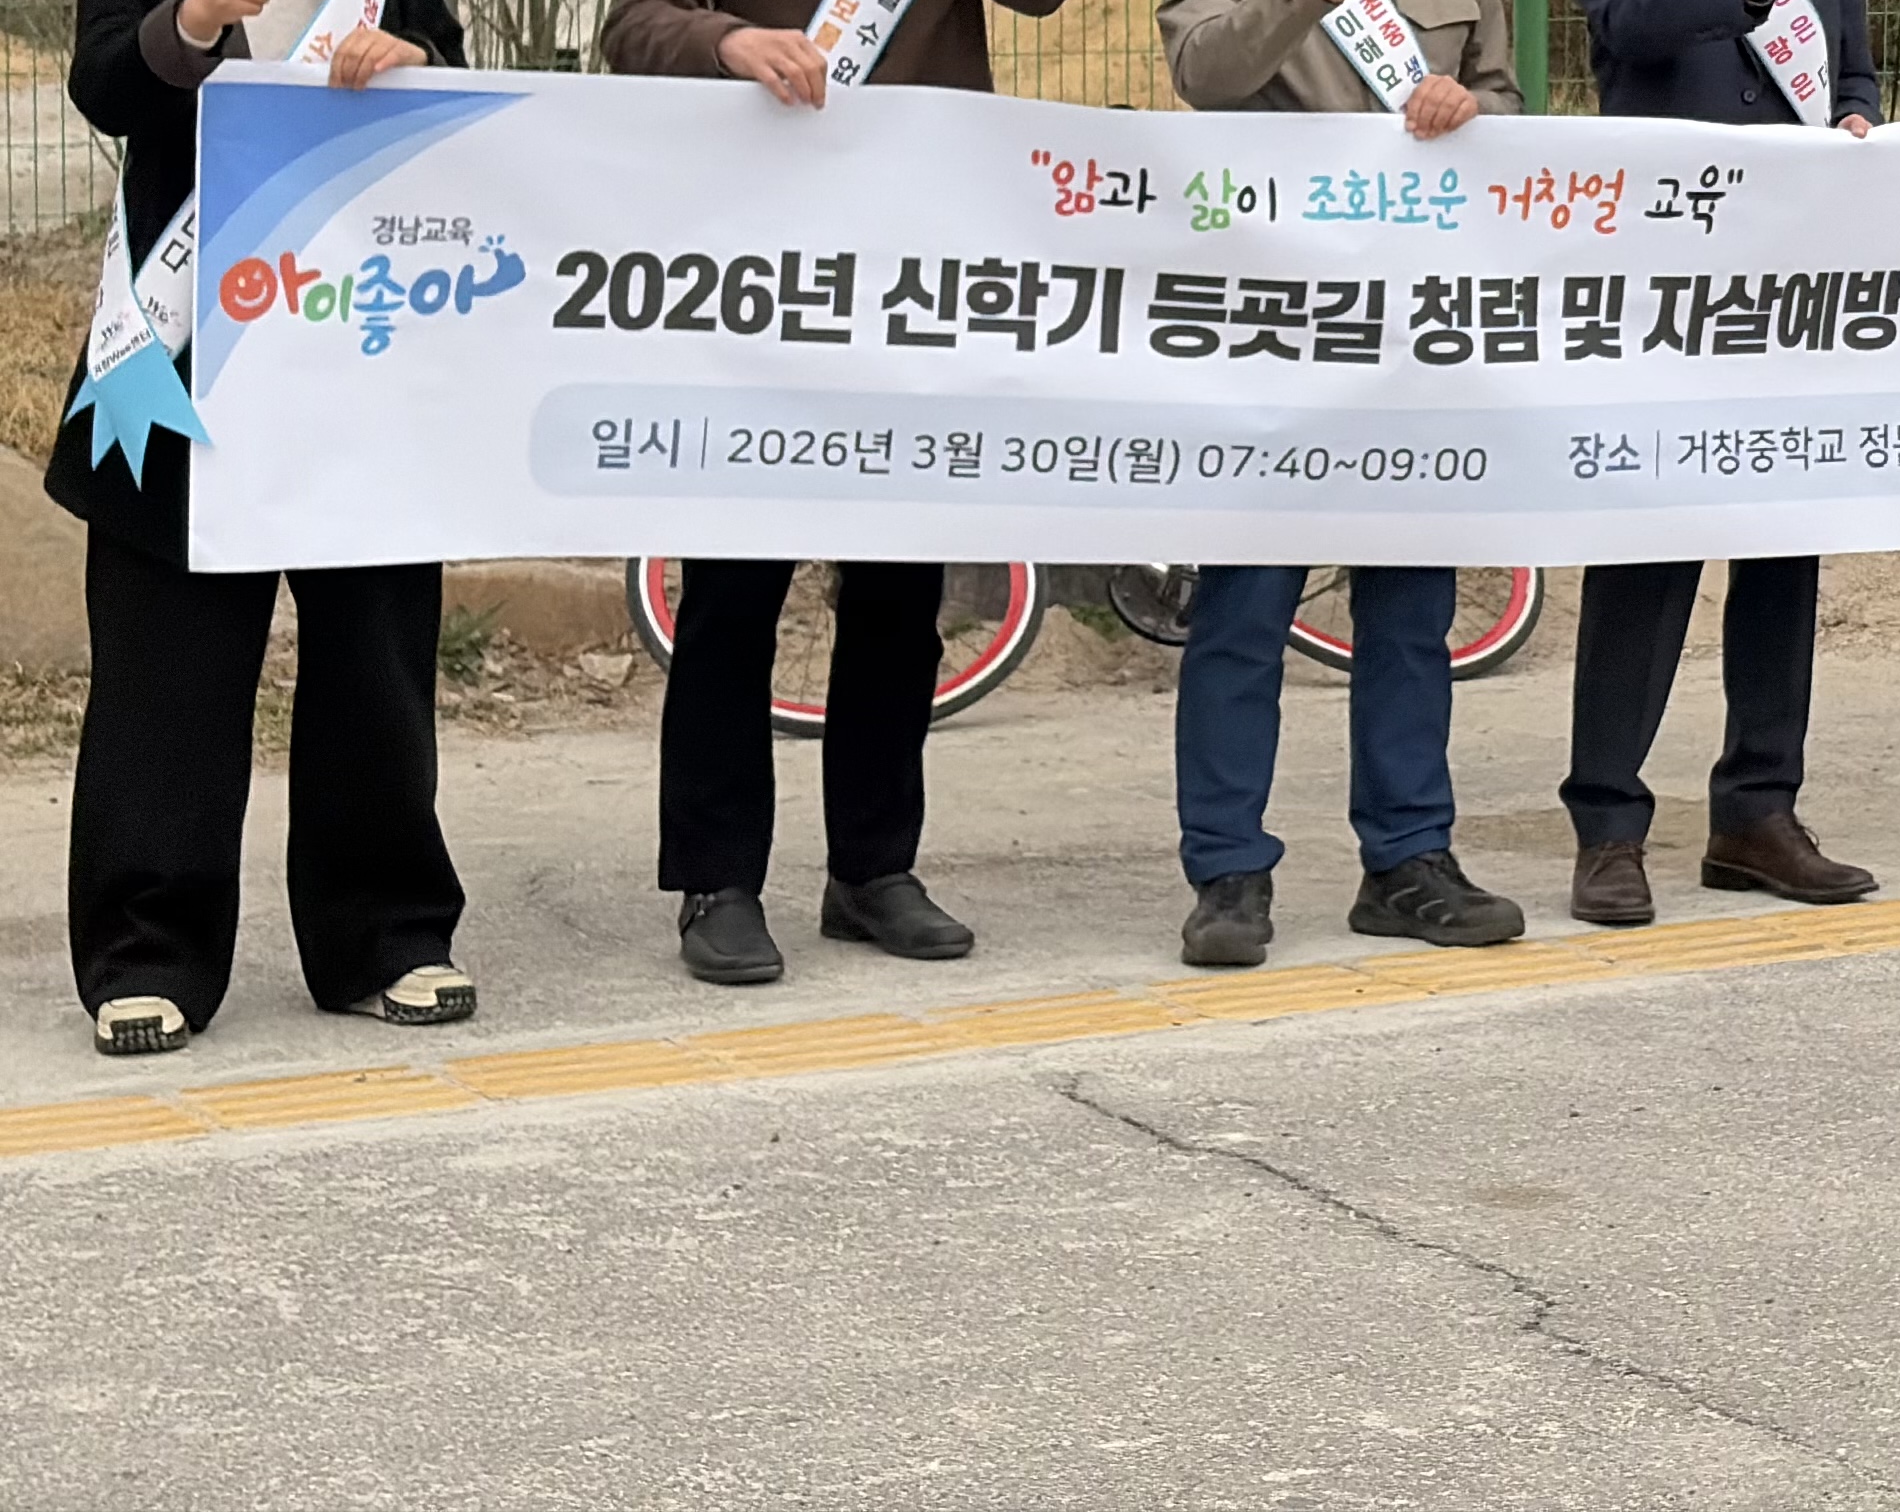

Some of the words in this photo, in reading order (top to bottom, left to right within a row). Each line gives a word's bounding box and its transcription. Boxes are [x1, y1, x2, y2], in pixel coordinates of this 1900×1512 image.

[856, 22, 881, 47] 수
[1334, 9, 1403, 93] 이해요
[372, 215, 473, 246] 경남교육
[1031, 149, 1157, 217] "앎과
[1183, 167, 1277, 232] 삶이
[1302, 167, 1468, 231] 조화로운
[1487, 166, 1626, 235] 거창얼
[1643, 164, 1745, 235] 교육"
[218, 250, 526, 356] 아이좋아
[552, 249, 858, 345] 2026년
[880, 256, 1127, 355] 신학기
[1146, 271, 1387, 365] 등굣길
[1408, 274, 1541, 366] 청렴
[1561, 273, 1627, 361] 및
[592, 418, 681, 470] 일시
[727, 427, 894, 475] 2026년
[911, 431, 984, 479] 3월
[1000, 435, 1181, 486] 30일(월)
[1197, 444, 1488, 482] 07:40~09:00
[1568, 432, 1642, 480] 장소
[1677, 425, 1848, 476] 거창중학교
